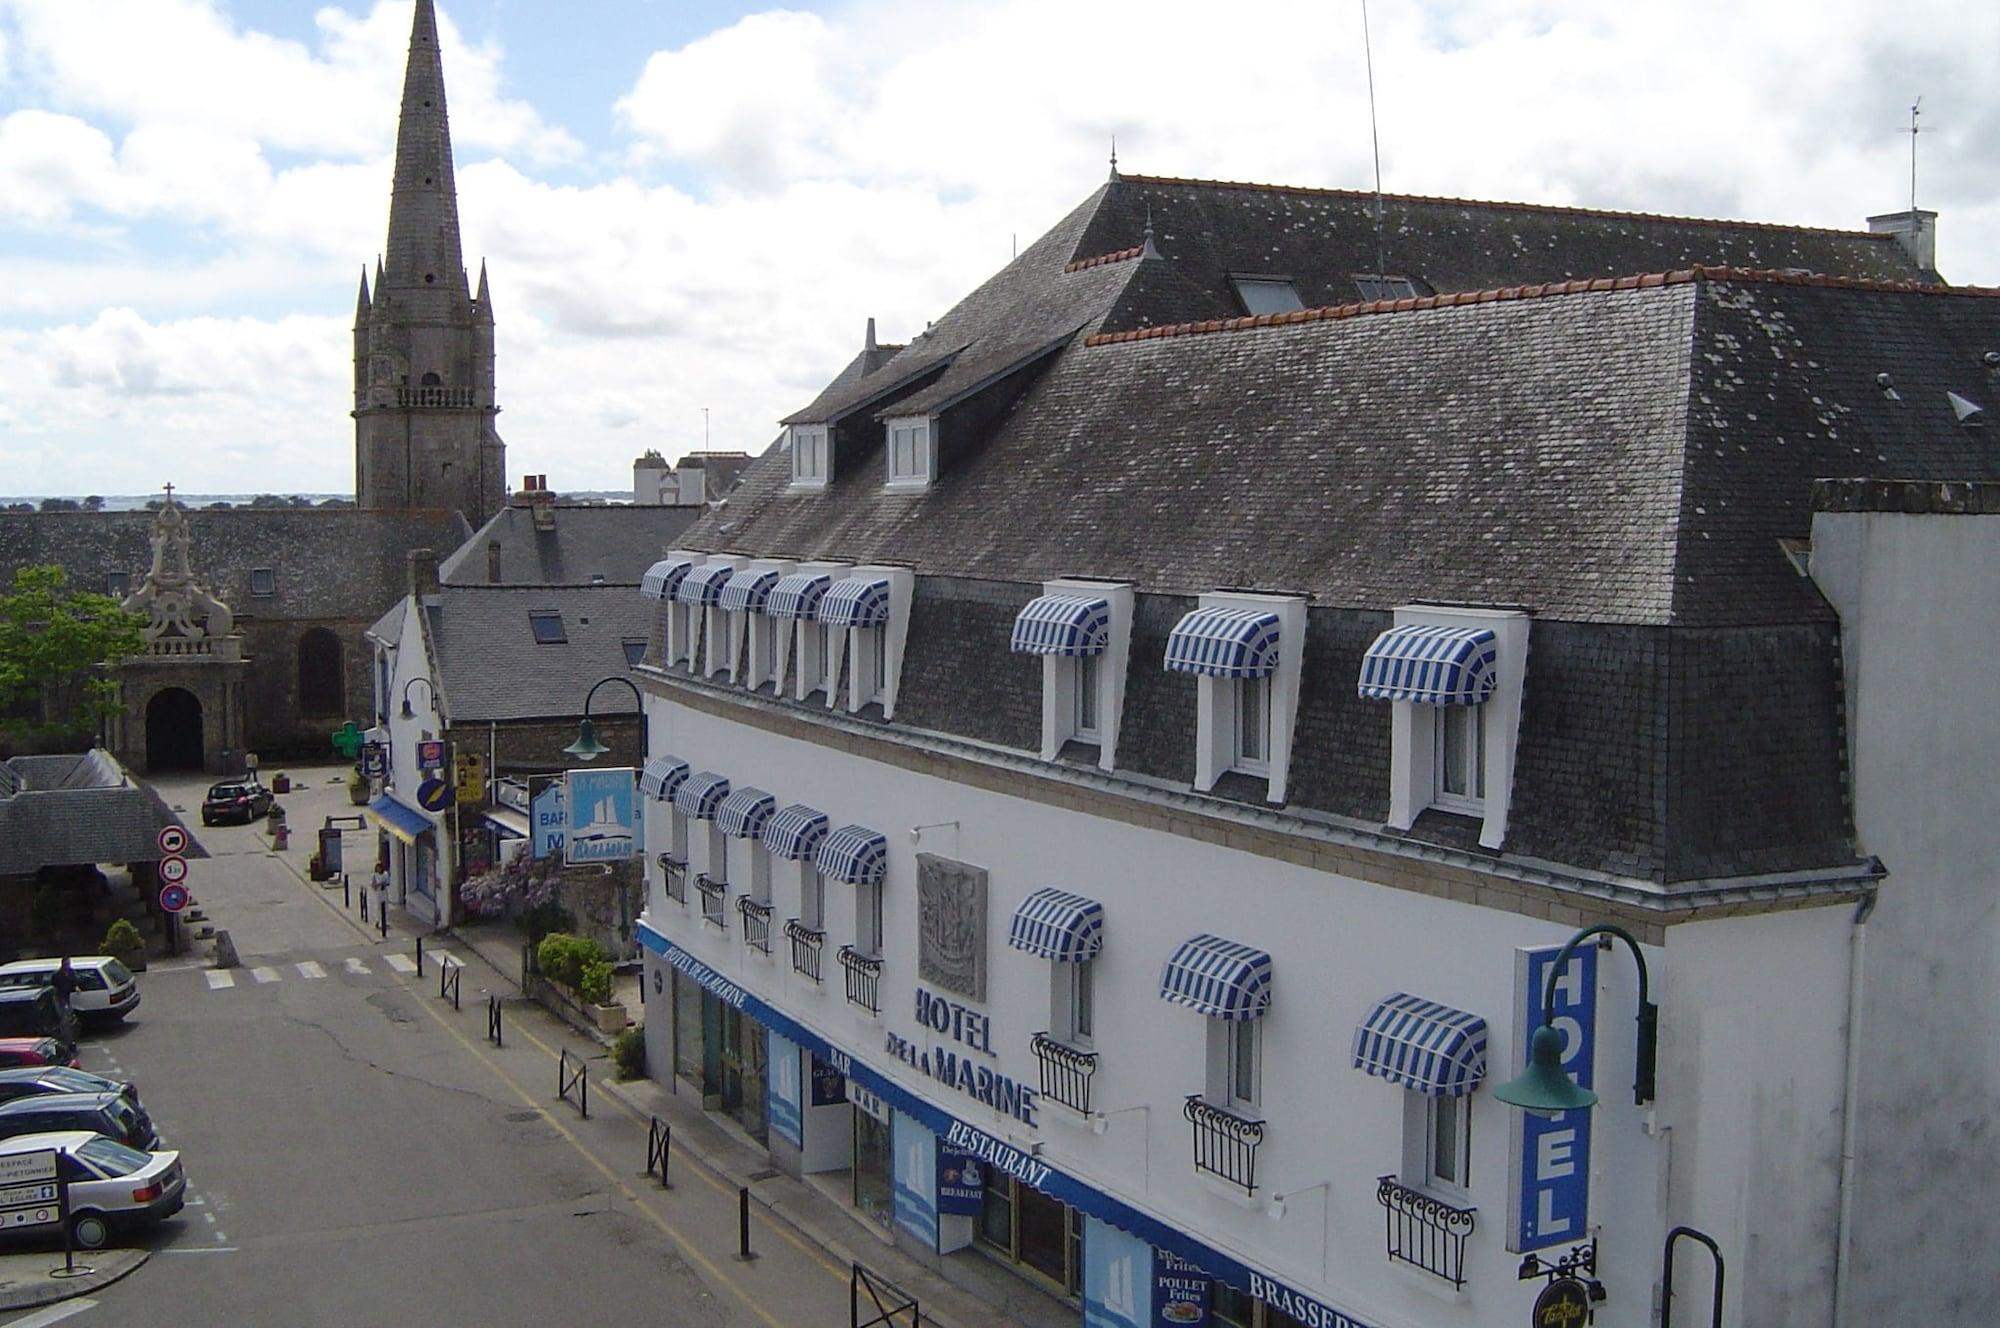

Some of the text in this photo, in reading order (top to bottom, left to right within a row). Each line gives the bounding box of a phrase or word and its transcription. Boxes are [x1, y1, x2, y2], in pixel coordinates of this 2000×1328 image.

[710, 977, 746, 1008] MARINE
[916, 987, 997, 1059] HOTEL
[831, 1048, 851, 1076] BAR
[885, 1031, 907, 1062] DE
[934, 1046, 1040, 1129] MARINE
[854, 1085, 880, 1115] BAR
[947, 1120, 1052, 1187] RESTAURANT
[941, 1187, 982, 1200] BREAKFAST
[1159, 1277, 1208, 1292] POULET
[1169, 1288, 1201, 1301] Frites
[1250, 1271, 1360, 1328] BRASSER
